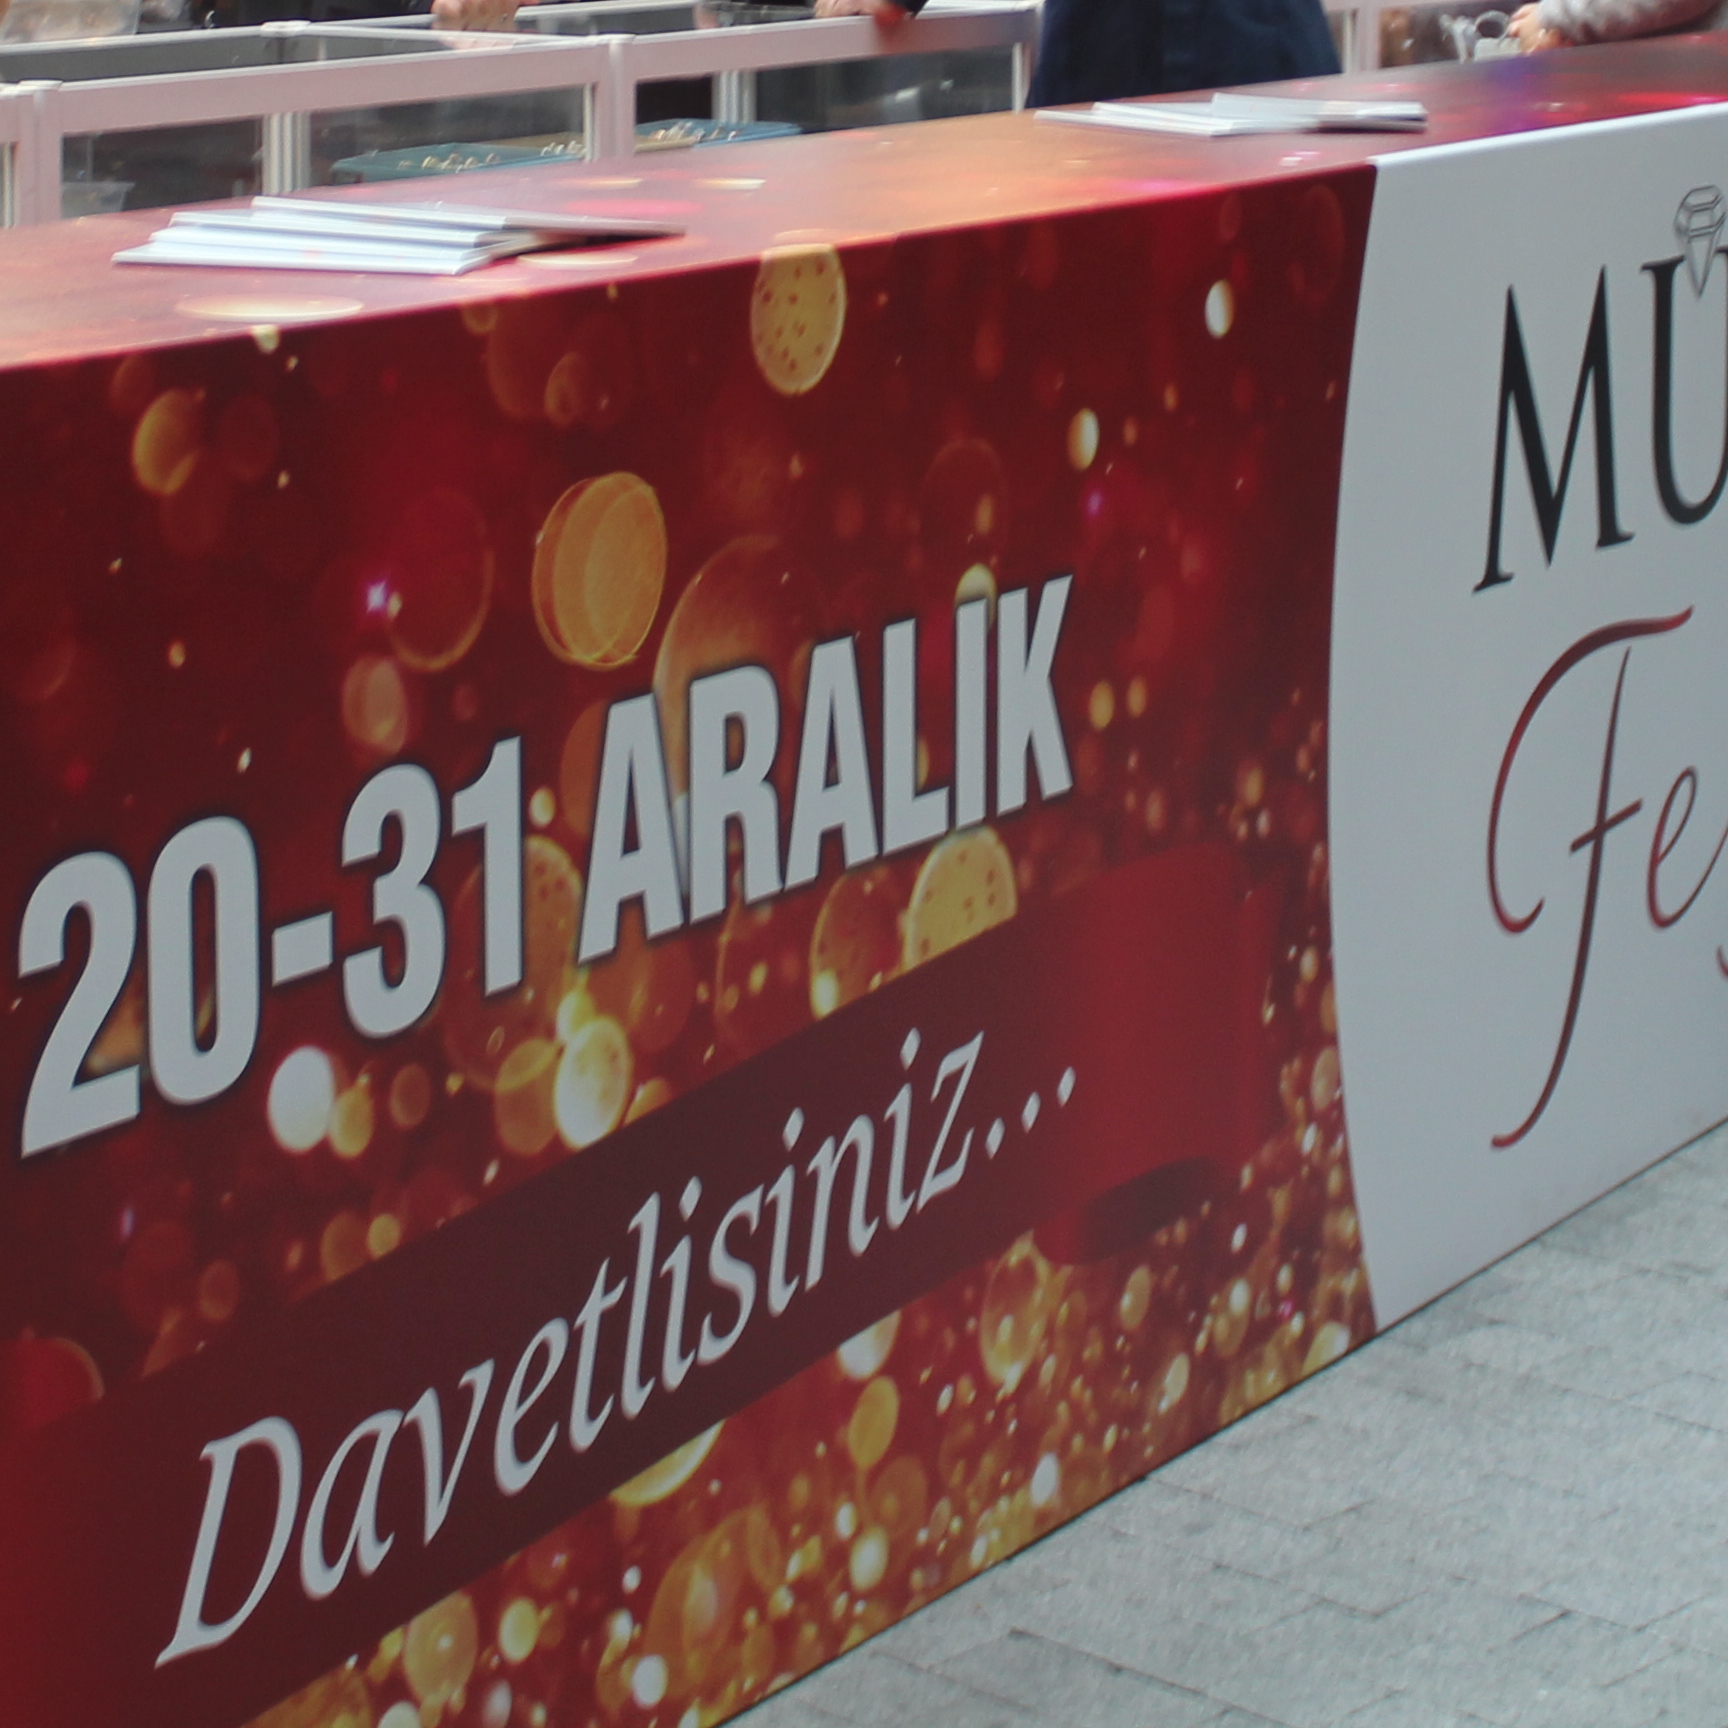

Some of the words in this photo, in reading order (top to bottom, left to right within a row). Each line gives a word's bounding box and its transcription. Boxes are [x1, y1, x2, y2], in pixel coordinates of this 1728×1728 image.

[17, 736, 524, 1160] 20-31
[576, 573, 1076, 964] ARALIK
[154, 1026, 1078, 1670] Davetlisiniz...
